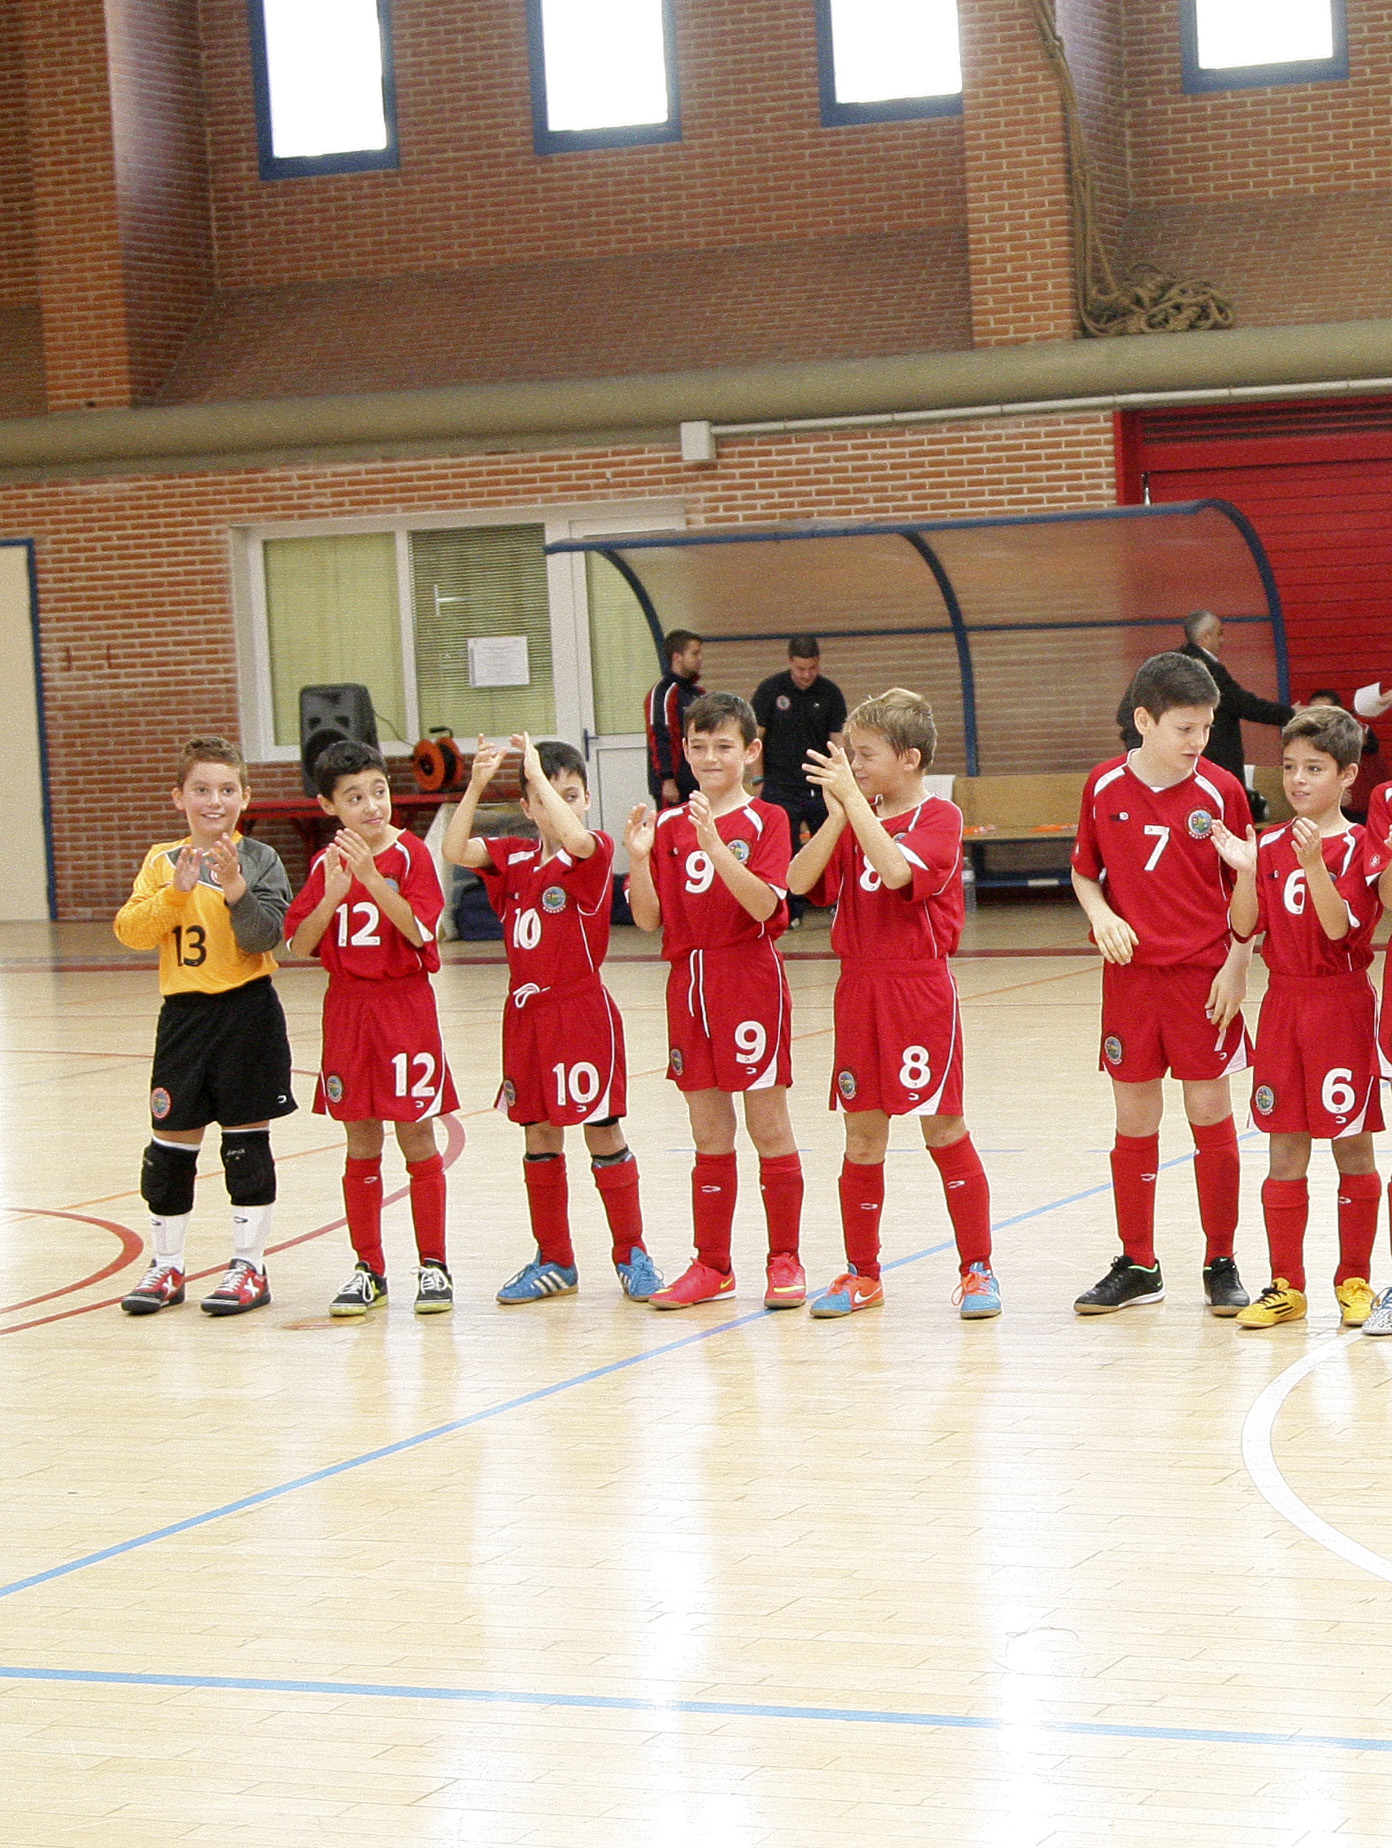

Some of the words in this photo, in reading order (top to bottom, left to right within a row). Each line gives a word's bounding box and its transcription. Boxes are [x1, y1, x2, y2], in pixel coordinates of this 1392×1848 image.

[1143, 825, 1170, 872] 7
[685, 851, 715, 893] 9
[1283, 868, 1307, 915] 6
[172, 924, 207, 968] 13
[337, 901, 382, 947] 12
[513, 907, 542, 950] 10
[734, 1020, 766, 1065] 9
[391, 1052, 437, 1098] 12
[551, 1062, 600, 1106] 10
[899, 1045, 931, 1090] 8
[1321, 1067, 1355, 1115] 6
